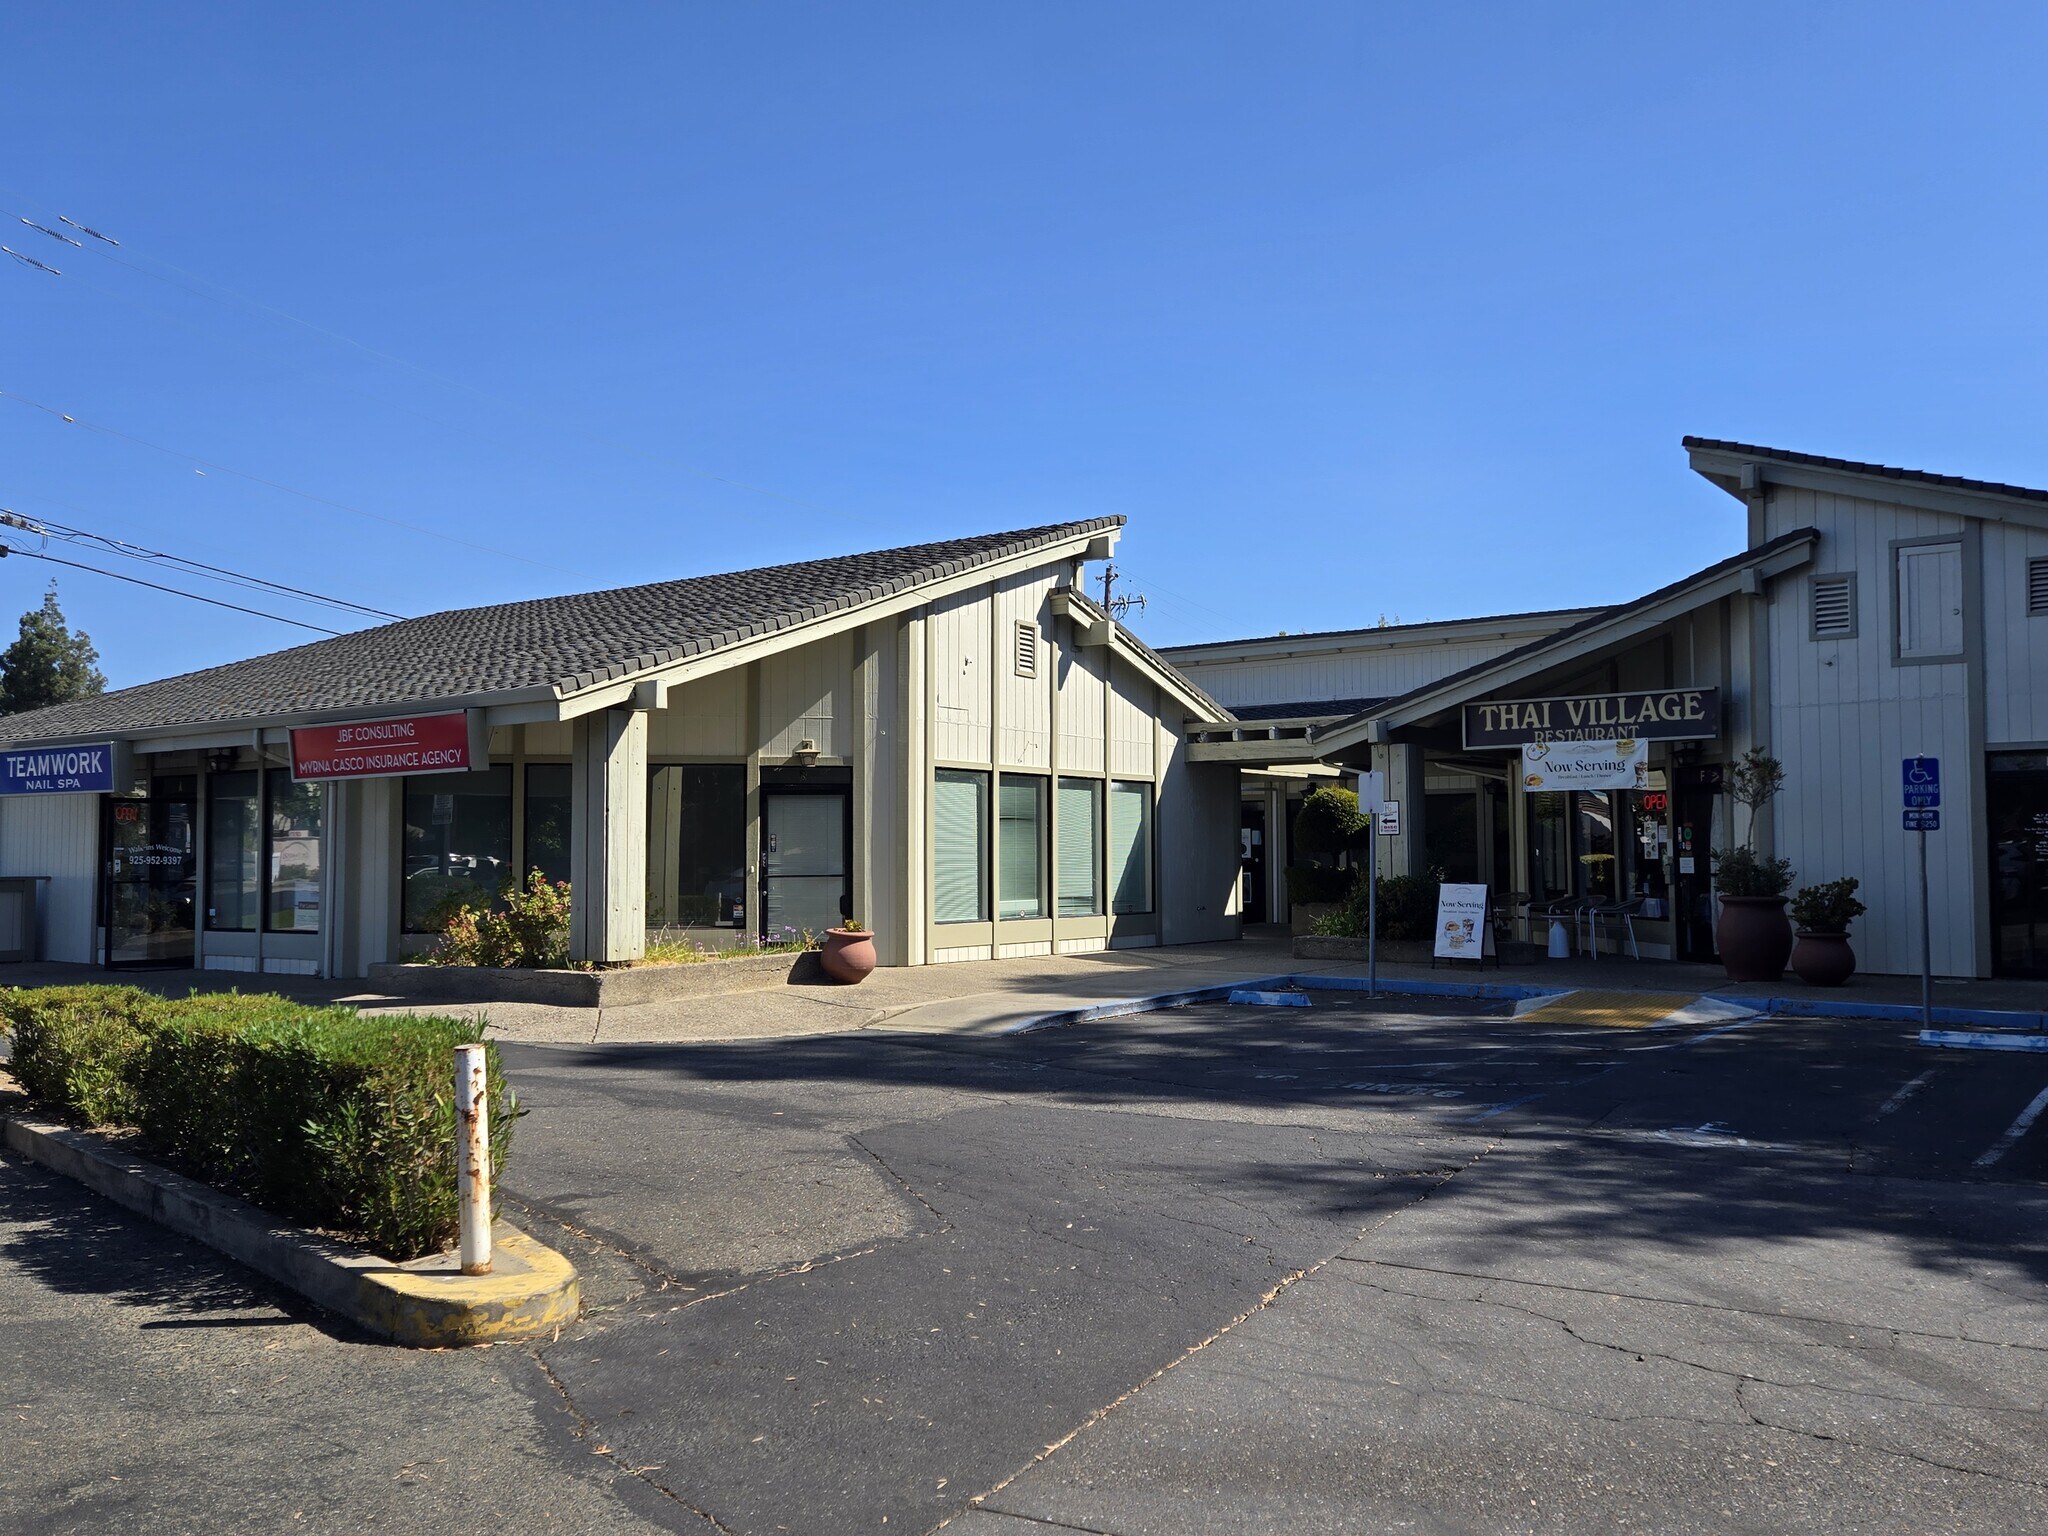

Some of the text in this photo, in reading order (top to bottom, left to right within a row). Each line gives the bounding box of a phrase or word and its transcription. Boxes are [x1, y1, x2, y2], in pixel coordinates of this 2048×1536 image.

[1478, 692, 1706, 732] THAI VILLAGE
[336, 722, 415, 742] JBF CONSULTING
[1534, 725, 1640, 744] RESTAURANT
[7, 751, 103, 777] TEAMWORK
[298, 749, 462, 774] MYRNA CASCO INSURANCE AGENCY
[1544, 759, 1627, 774] Now Serving
[26, 778, 81, 790] NAIL SPA
[1904, 783, 1939, 794] PARKING
[1911, 795, 1932, 806] ONLY
[116, 807, 139, 822] OPEN
[1905, 820, 1918, 828] FINE
[128, 855, 183, 865] 925-952-9397
[1440, 899, 1484, 911] Now Serving
